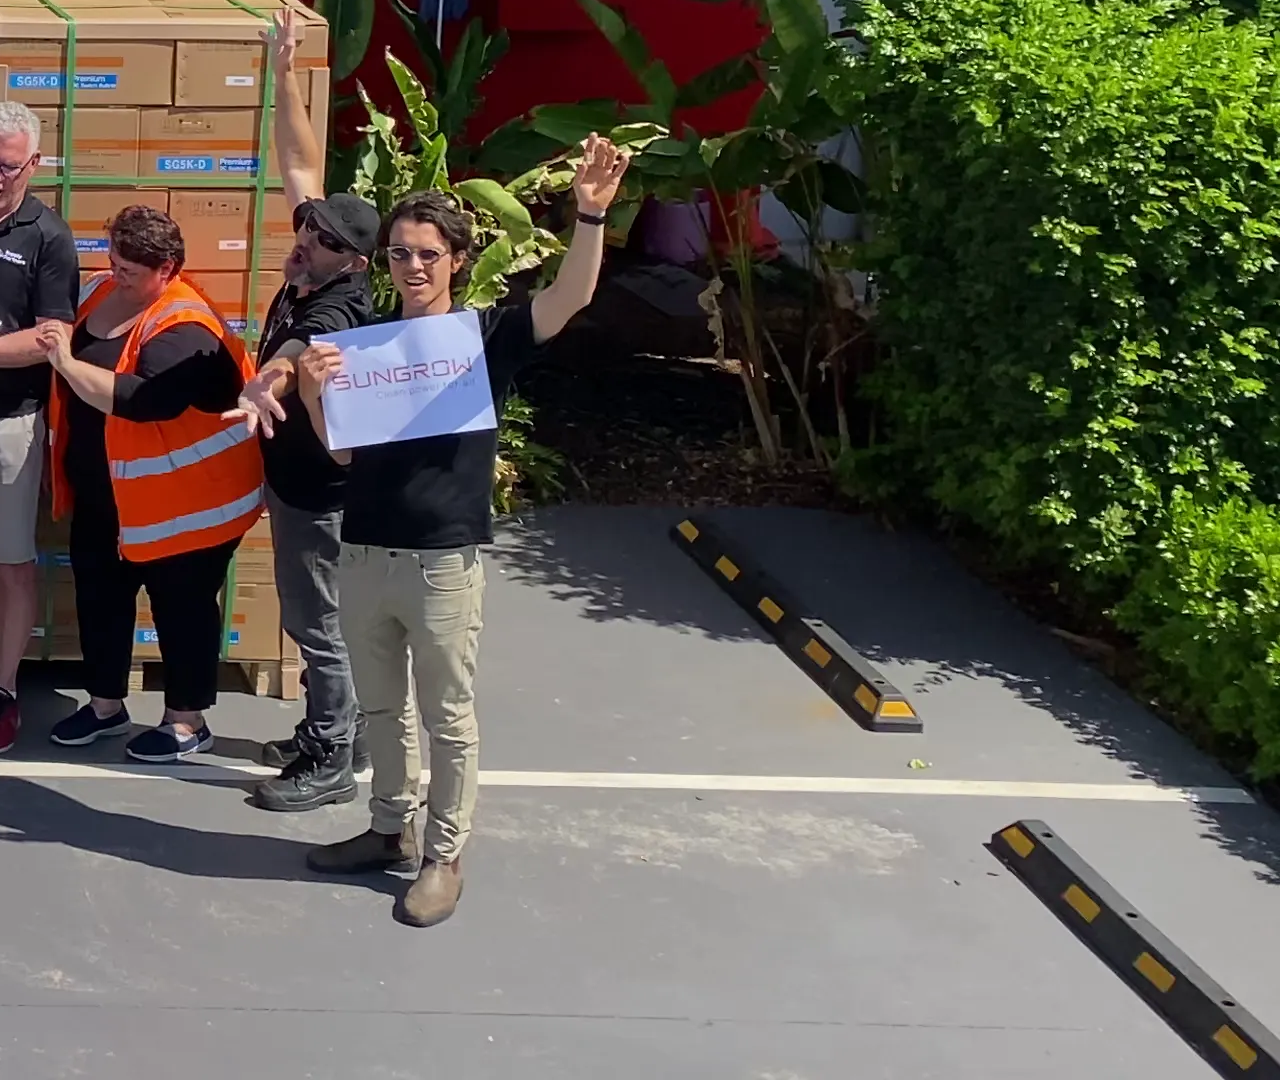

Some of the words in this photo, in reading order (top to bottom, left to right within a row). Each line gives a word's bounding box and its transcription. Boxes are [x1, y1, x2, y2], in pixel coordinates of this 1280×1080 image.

[16, 76, 58, 87] SG5K-D
[164, 160, 206, 170] SG5K-D
[331, 356, 473, 391] SUNGROW
